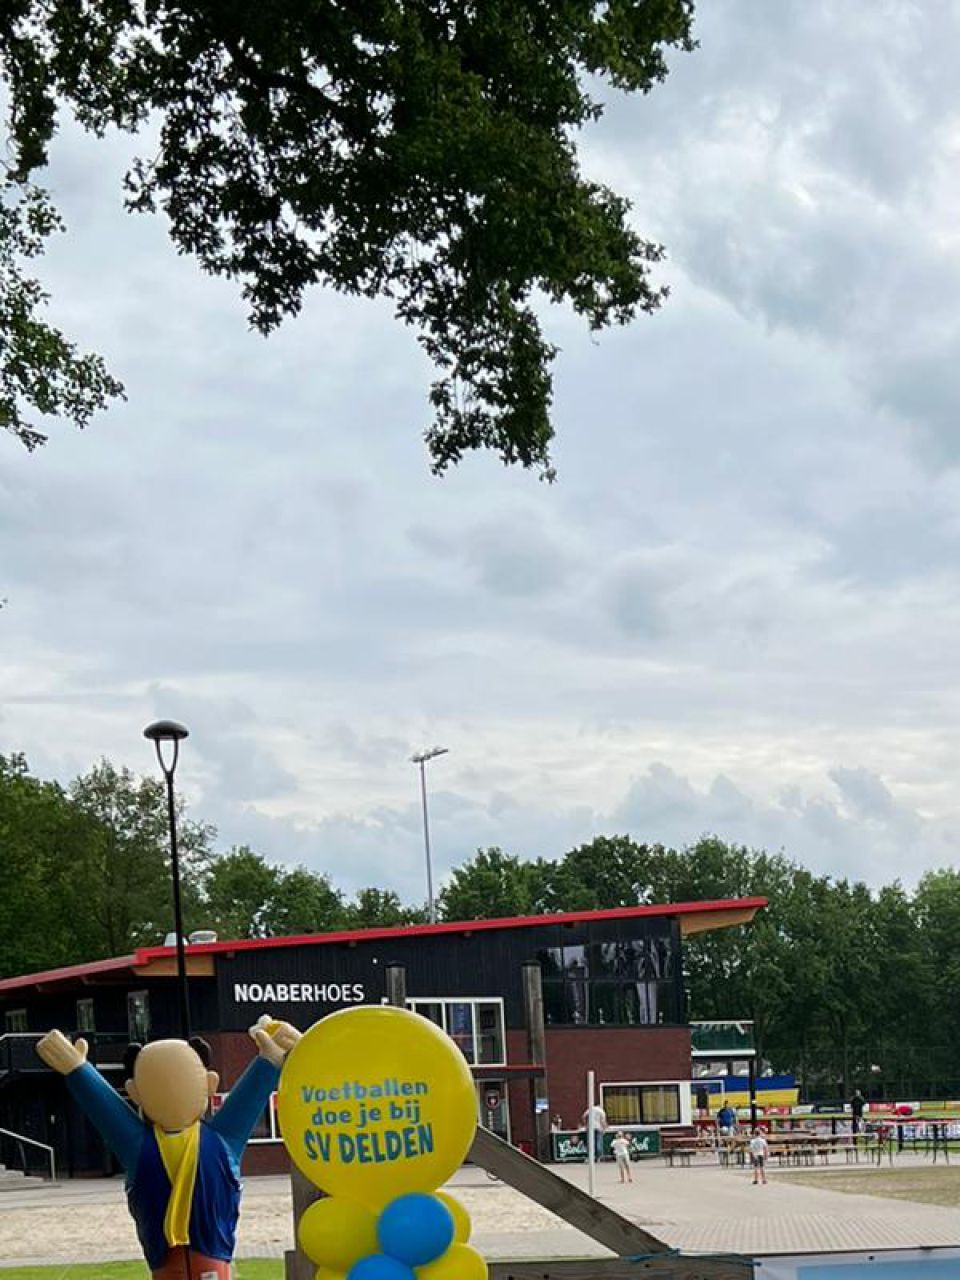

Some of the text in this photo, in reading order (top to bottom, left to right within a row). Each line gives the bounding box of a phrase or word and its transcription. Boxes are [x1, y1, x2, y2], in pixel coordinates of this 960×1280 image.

[234, 983, 365, 1003] NOABERHOES
[301, 1078, 428, 1103] Voetballen
[312, 1099, 420, 1128] doe je bij
[303, 1123, 434, 1163] SV DELDEN
